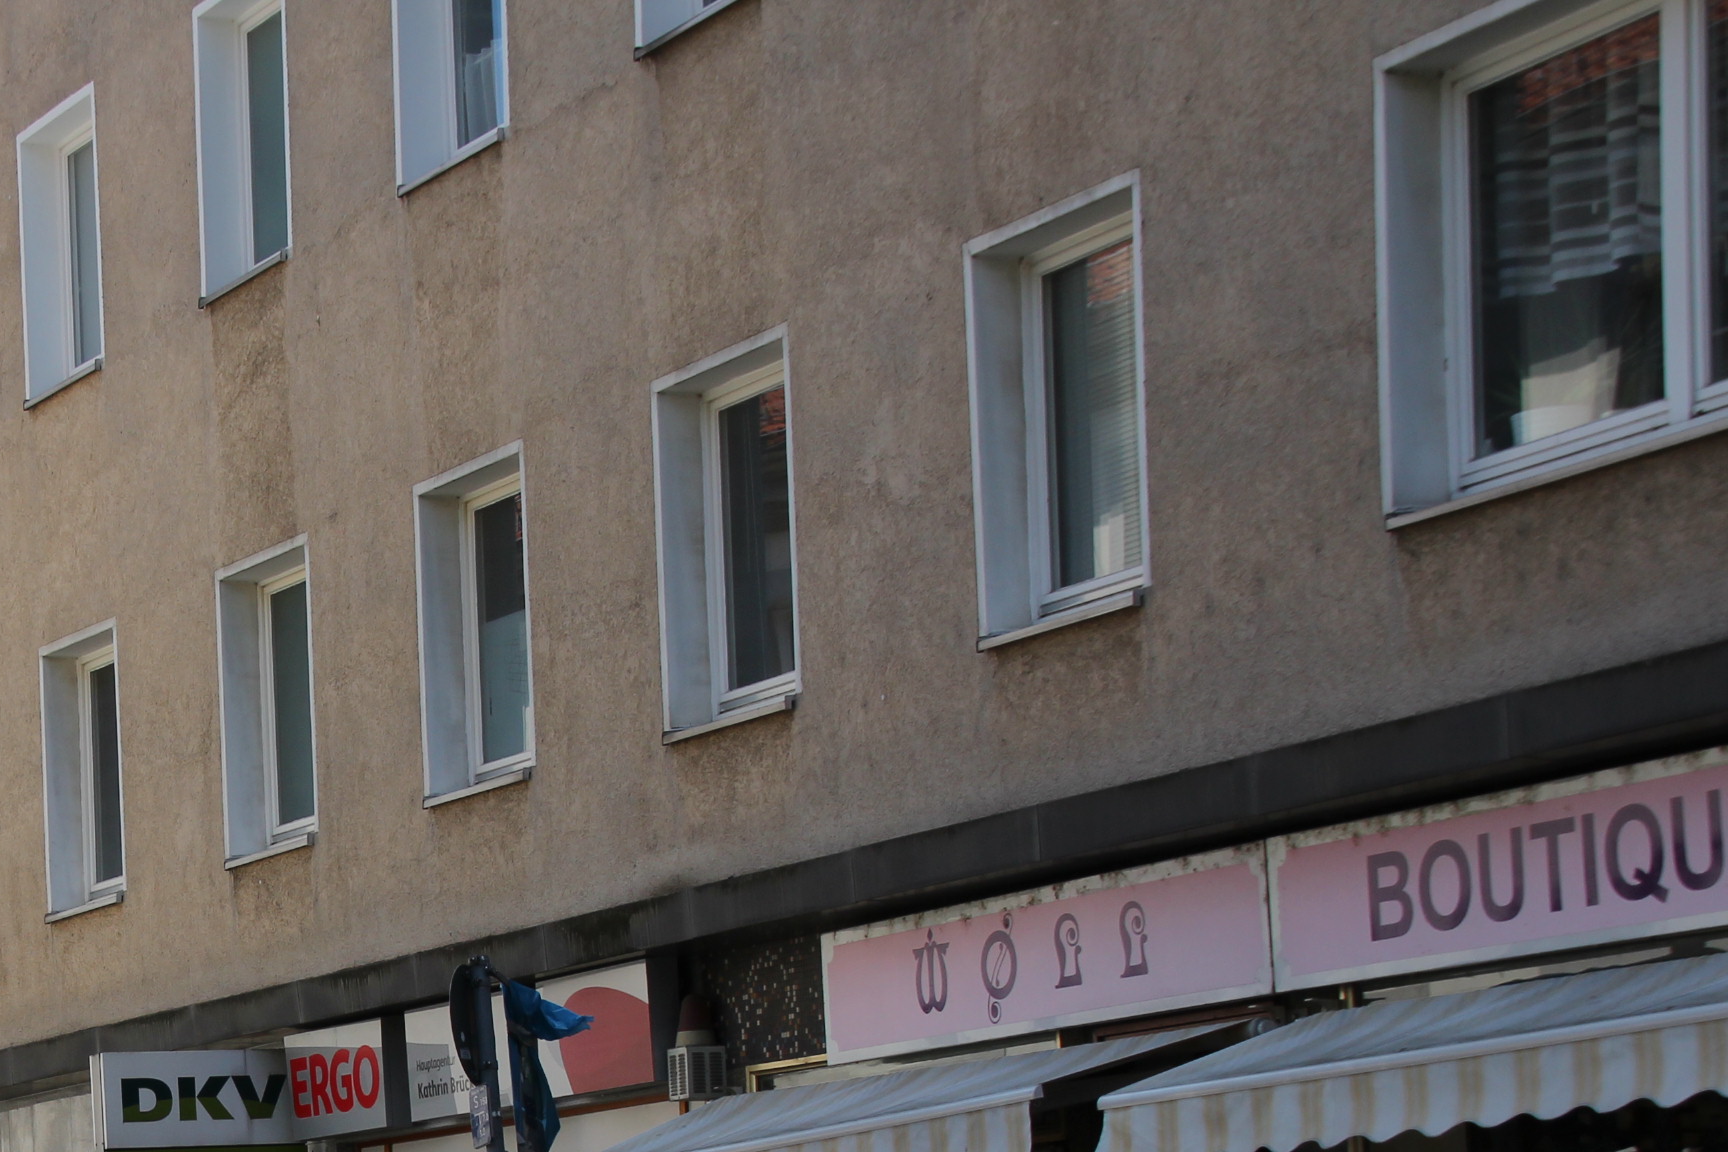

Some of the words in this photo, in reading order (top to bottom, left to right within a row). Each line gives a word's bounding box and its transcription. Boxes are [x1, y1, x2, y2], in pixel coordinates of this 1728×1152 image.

[912, 901, 1149, 1024] WOLL
[1367, 789, 1724, 942] BOUTIQU
[290, 1045, 380, 1119] ERGO
[416, 1055, 456, 1073] Hauptagentur
[417, 1078, 449, 1100] Kathrin
[450, 1074, 471, 1094] Brüc
[120, 1073, 287, 1124] DKV
